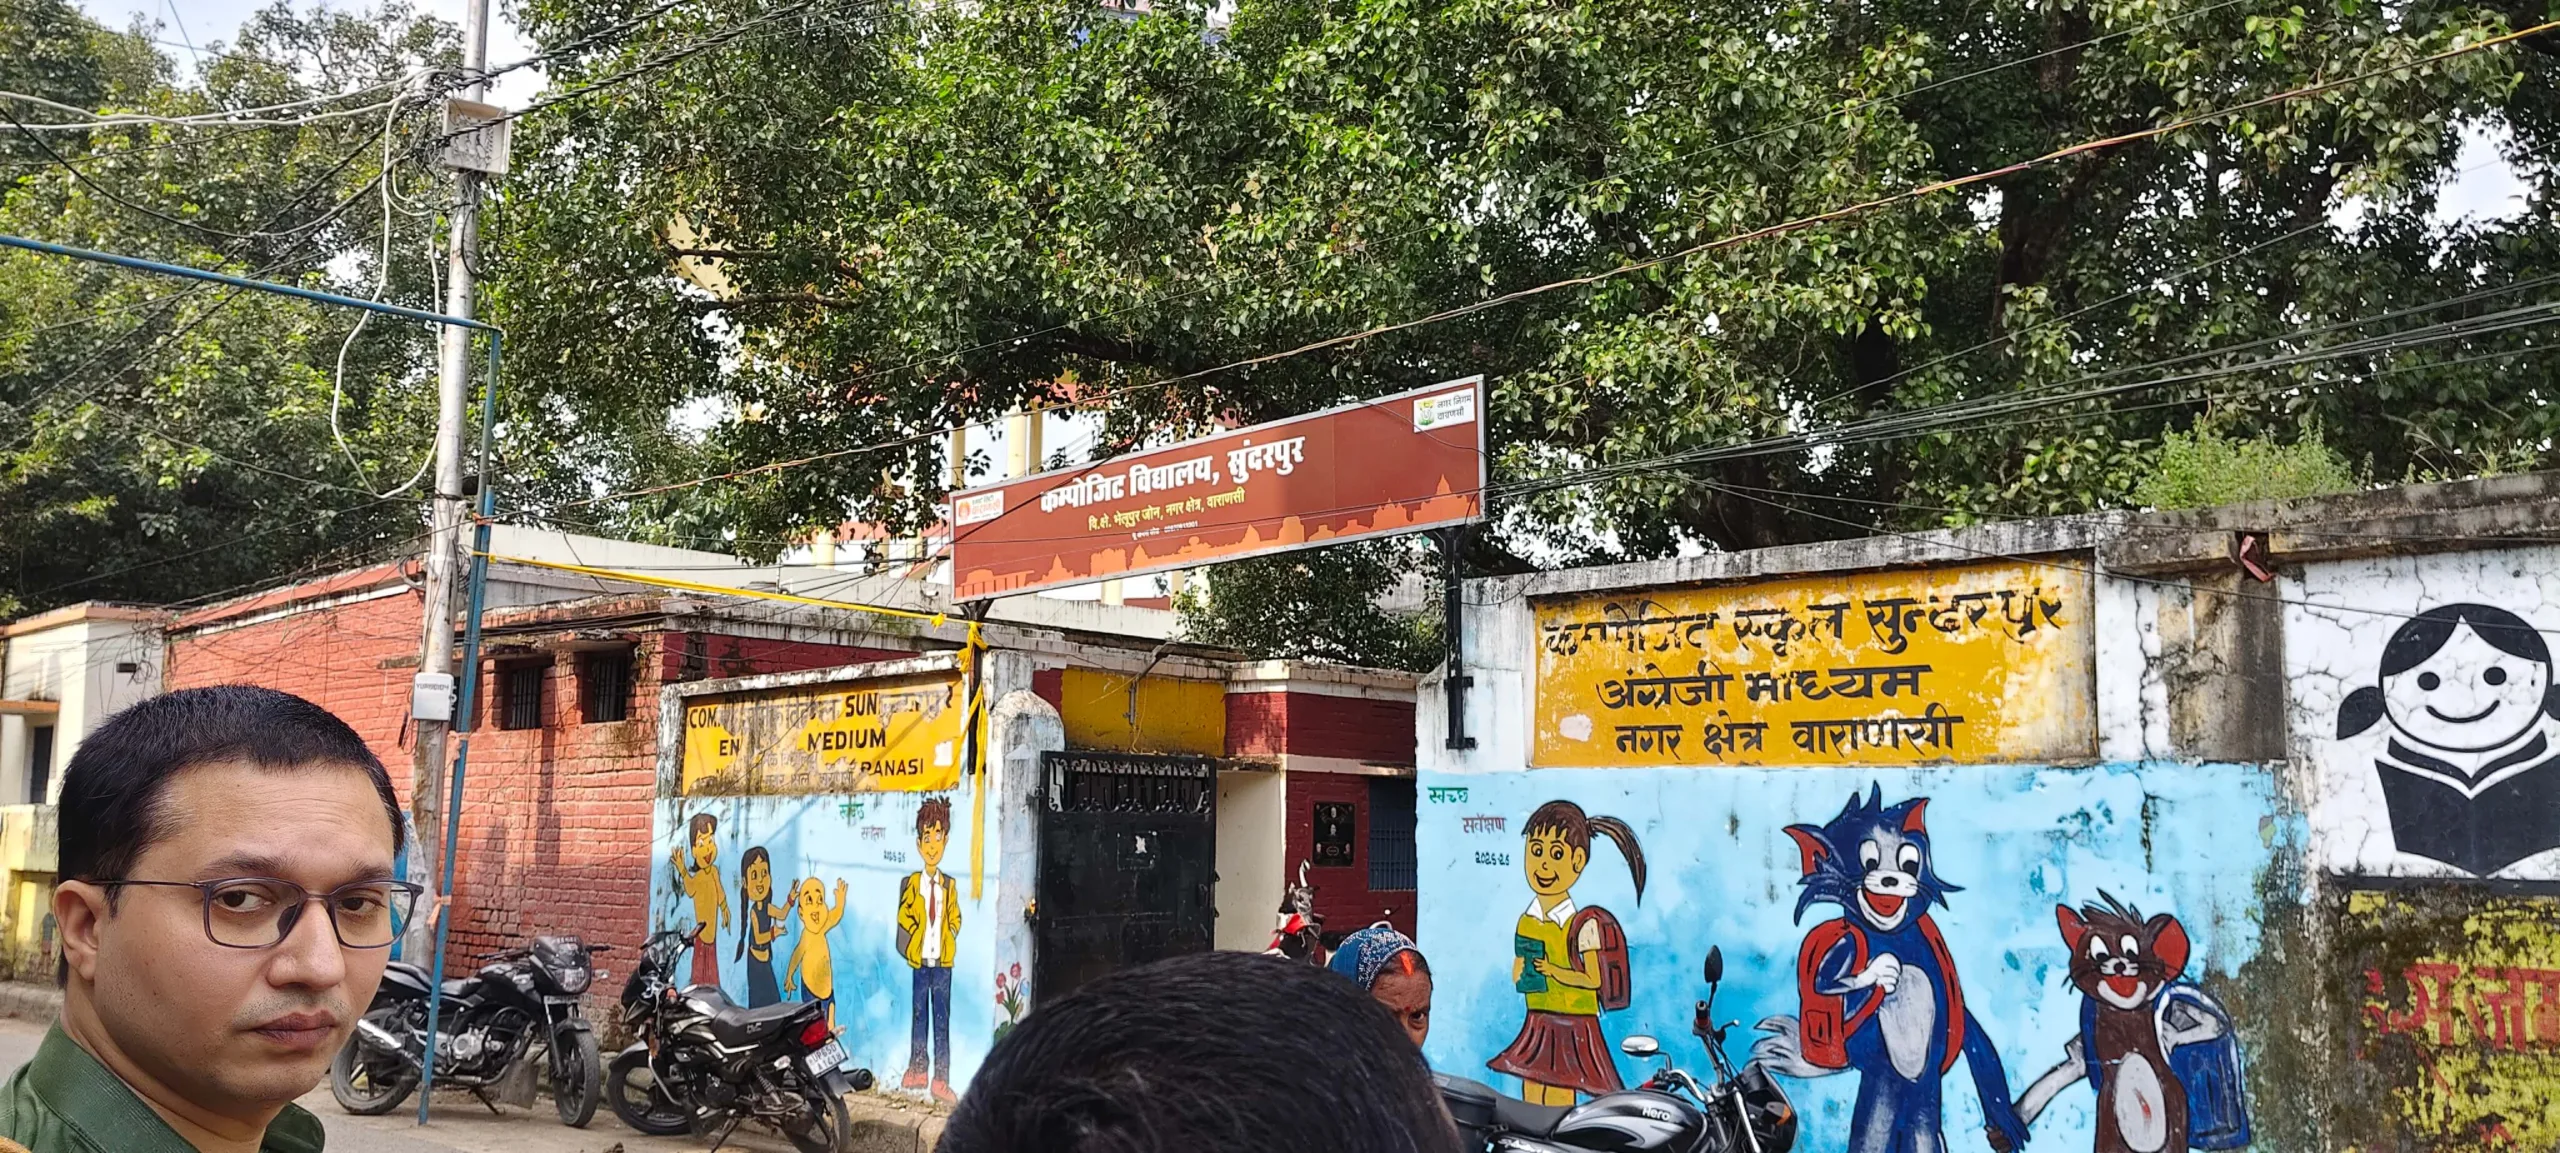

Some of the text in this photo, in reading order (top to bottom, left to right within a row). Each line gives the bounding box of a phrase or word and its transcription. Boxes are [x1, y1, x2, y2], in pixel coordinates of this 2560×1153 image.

[1040, 436, 1305, 513] कम्पोजिट विद्यालय, सुंदरपुर
[1165, 502, 1184, 516] नगर
[1206, 486, 1245, 508] वाराणसी
[1596, 660, 1932, 709] अंग्रेजी माध्यम
[808, 728, 886, 751] MEDIUM
[1615, 702, 1965, 761] नगर क्षेत्र वाराणसी
[1642, 1105, 1671, 1121] Hero
